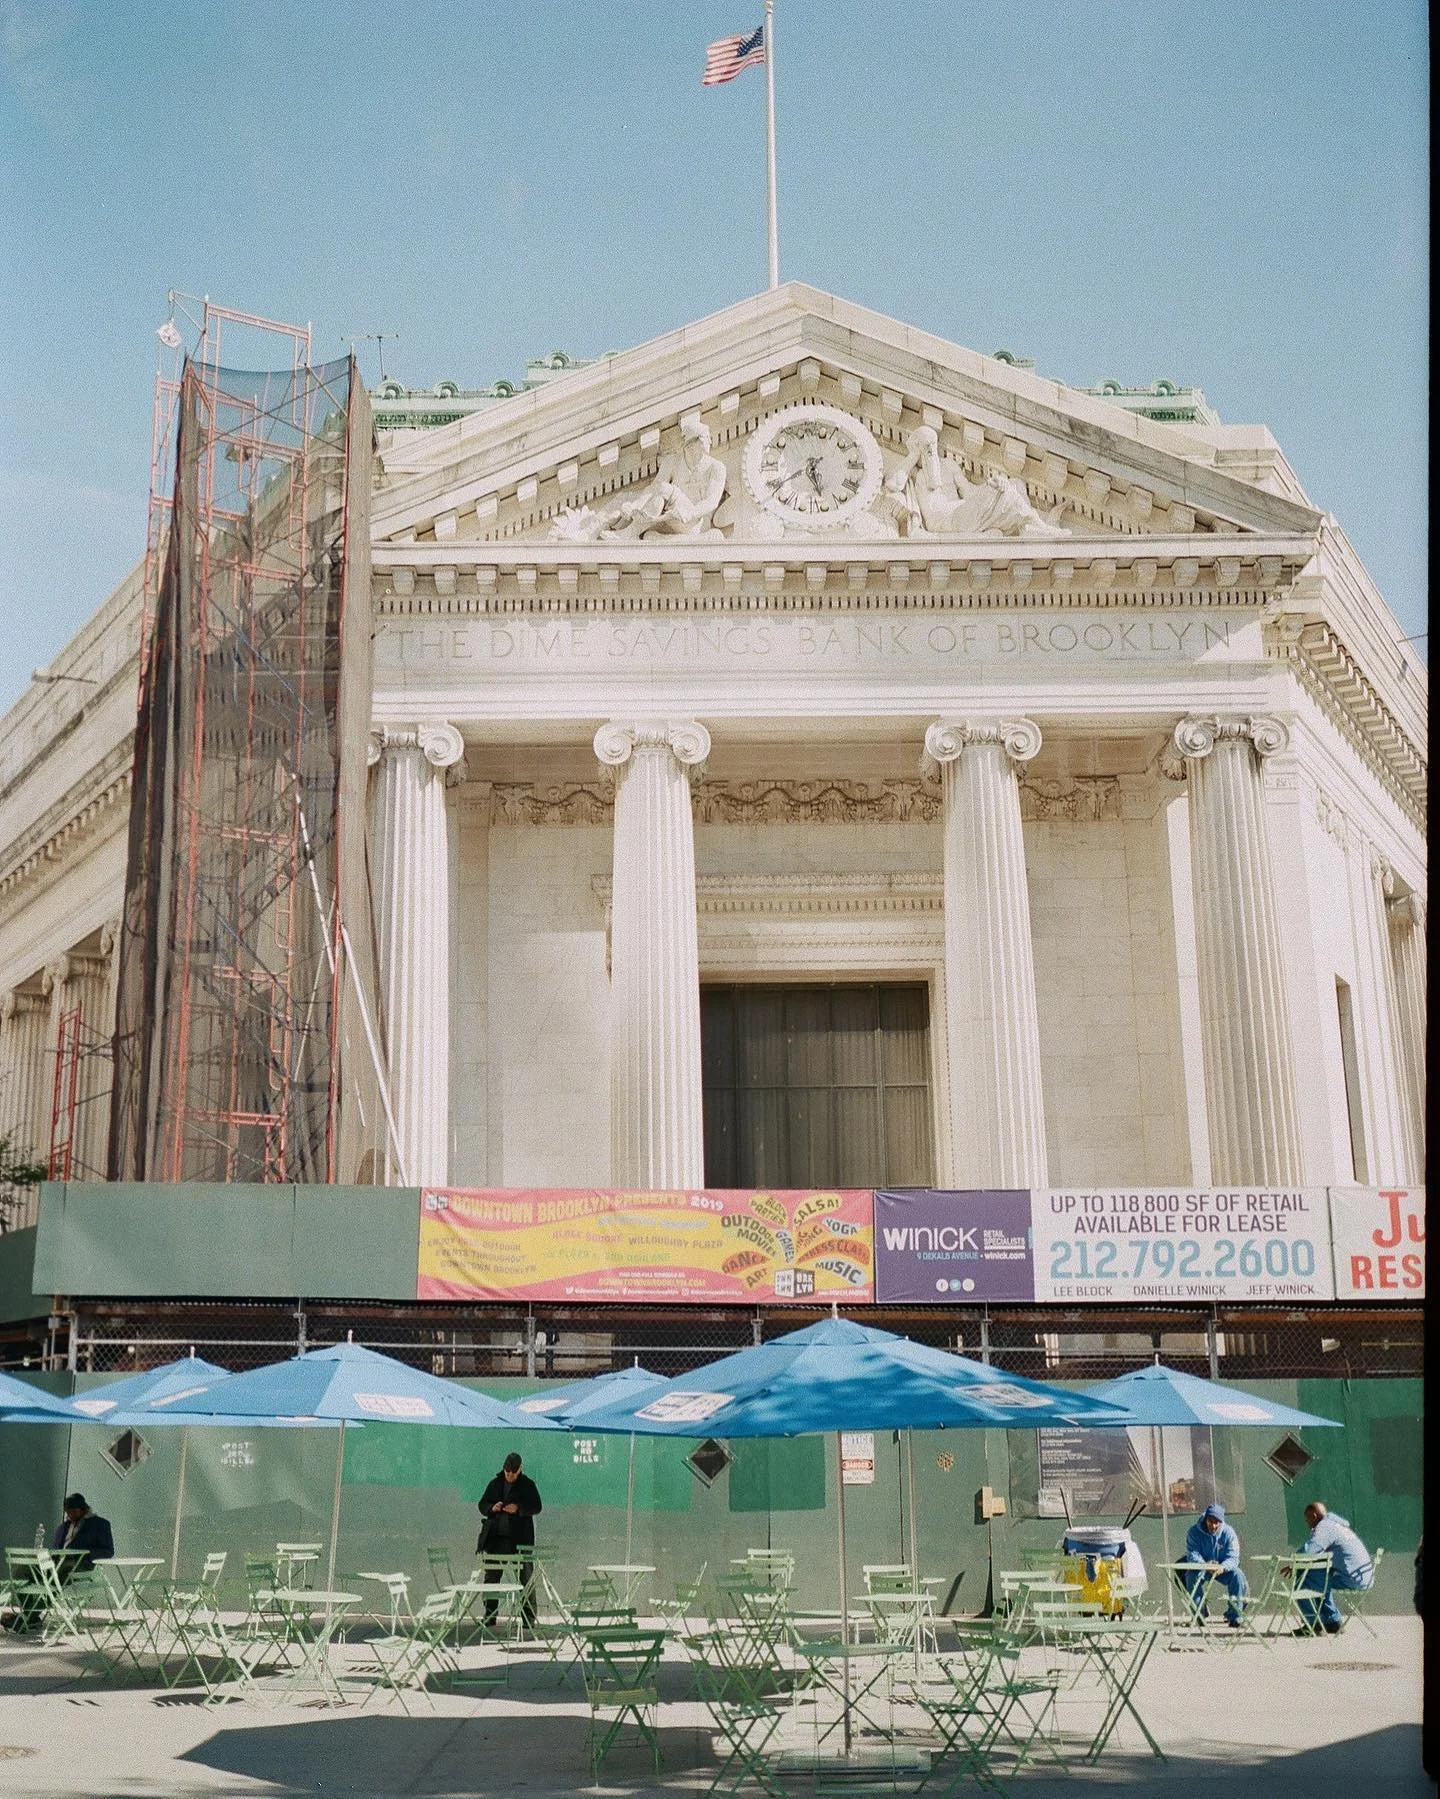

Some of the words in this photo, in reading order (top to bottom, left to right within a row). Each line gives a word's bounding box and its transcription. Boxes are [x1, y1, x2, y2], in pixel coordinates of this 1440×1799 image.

[388, 629, 473, 659] THE
[490, 628, 591, 659] DIME
[607, 626, 772, 659] SAVINGS
[800, 625, 914, 656] BANK
[927, 624, 979, 654] OF
[998, 621, 1231, 655] BROOKLYN
[452, 1193, 533, 1224] DOWNTOWN
[537, 1195, 610, 1224] BROOKLYN
[690, 1195, 724, 1211] 2019
[793, 1198, 839, 1226] SALSA!
[1050, 1195, 1076, 1213] UP
[1080, 1195, 1104, 1213] TO
[1185, 1194, 1209, 1213] SF
[1215, 1194, 1241, 1212] OF
[1246, 1194, 1310, 1212] RETAIL
[721, 1214, 775, 1244] OUTDOOR
[825, 1218, 858, 1236] YOGA
[1074, 1215, 1177, 1234] AVAILABLE
[1182, 1214, 1220, 1233] FOR
[1226, 1214, 1288, 1233] LEASE
[628, 1235, 689, 1249] WILLOUGHBY
[951, 1252, 979, 1260] AVENUE
[984, 1251, 1026, 1261] winick.com
[1050, 1239, 1315, 1279] 212.792.2600
[746, 1268, 768, 1288] ART
[815, 1261, 862, 1284] MUSIC
[1350, 1254, 1423, 1289] RES
[1053, 1286, 1073, 1297] LEE
[1076, 1286, 1113, 1297] BLOCK
[1133, 1285, 1184, 1296] DANIELLE
[1186, 1285, 1227, 1296] WINICK
[1246, 1285, 1272, 1296] JEFF
[1274, 1284, 1315, 1296] WINICK
[573, 1439, 598, 1448] POST
[573, 1454, 599, 1464] BILLS
